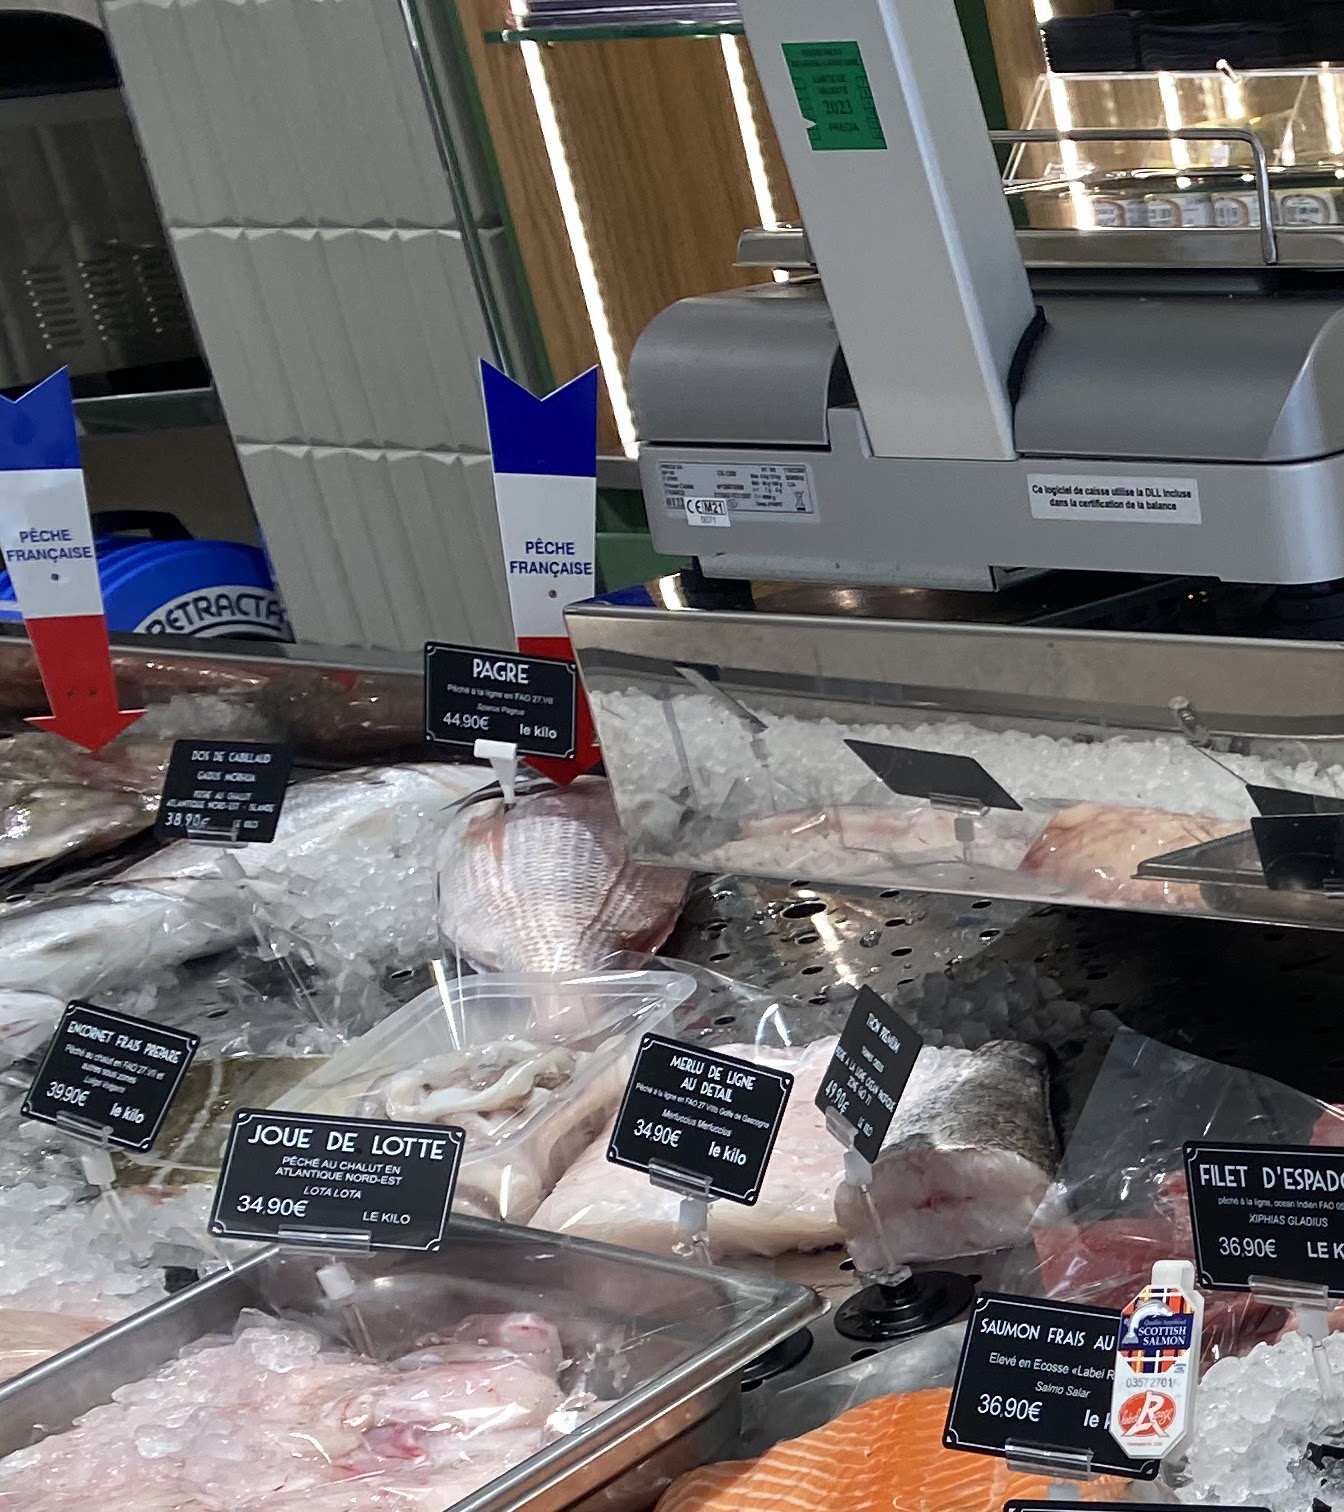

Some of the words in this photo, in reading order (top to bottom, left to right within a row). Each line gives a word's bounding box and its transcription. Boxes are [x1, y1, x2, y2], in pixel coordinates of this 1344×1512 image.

[1074, 486, 1083, 494] de
[1085, 487, 1109, 496] caisse
[1145, 488, 1161, 497] DLL
[704, 502, 724, 514] M21
[20, 528, 71, 543] PÊCHE
[7, 546, 93, 563] FRANÇAISE
[525, 538, 575, 556] PÊCHE
[510, 561, 593, 578] FRANÇAISE
[472, 658, 529, 684] PAGRE
[519, 724, 530, 735] le
[534, 724, 557, 739] kilo
[670, 1055, 704, 1075] MERLU
[708, 1065, 724, 1081] DE
[728, 1071, 756, 1091] LIGNE
[680, 1077, 696, 1091] AU
[110, 1103, 120, 1117] le
[122, 1106, 145, 1123] kilo
[248, 1124, 314, 1149] JOUE
[326, 1131, 358, 1153] DE
[371, 1135, 447, 1160] LOTTE
[708, 1141, 721, 1157] le
[723, 1145, 747, 1165] kilo
[321, 1160, 338, 1170] AU
[339, 1161, 382, 1174] CHALUT
[385, 1164, 401, 1174] EN
[274, 1167, 343, 1181] ATLANTIQUE
[345, 1172, 402, 1185] NORD-EST
[1199, 1164, 1248, 1188] FILET
[363, 1210, 379, 1222] LE
[382, 1212, 411, 1225] KILO
[1249, 1214, 1285, 1225] XIPHIAS
[1288, 1217, 1328, 1227] GLADIUS
[1307, 1241, 1328, 1259] LE
[980, 1318, 1040, 1340] SAUMON
[1047, 1327, 1086, 1347] FRAIS
[1093, 1335, 1115, 1350] AU
[1138, 1326, 1186, 1337] SCOTTISH
[1143, 1335, 1186, 1346] SALMON
